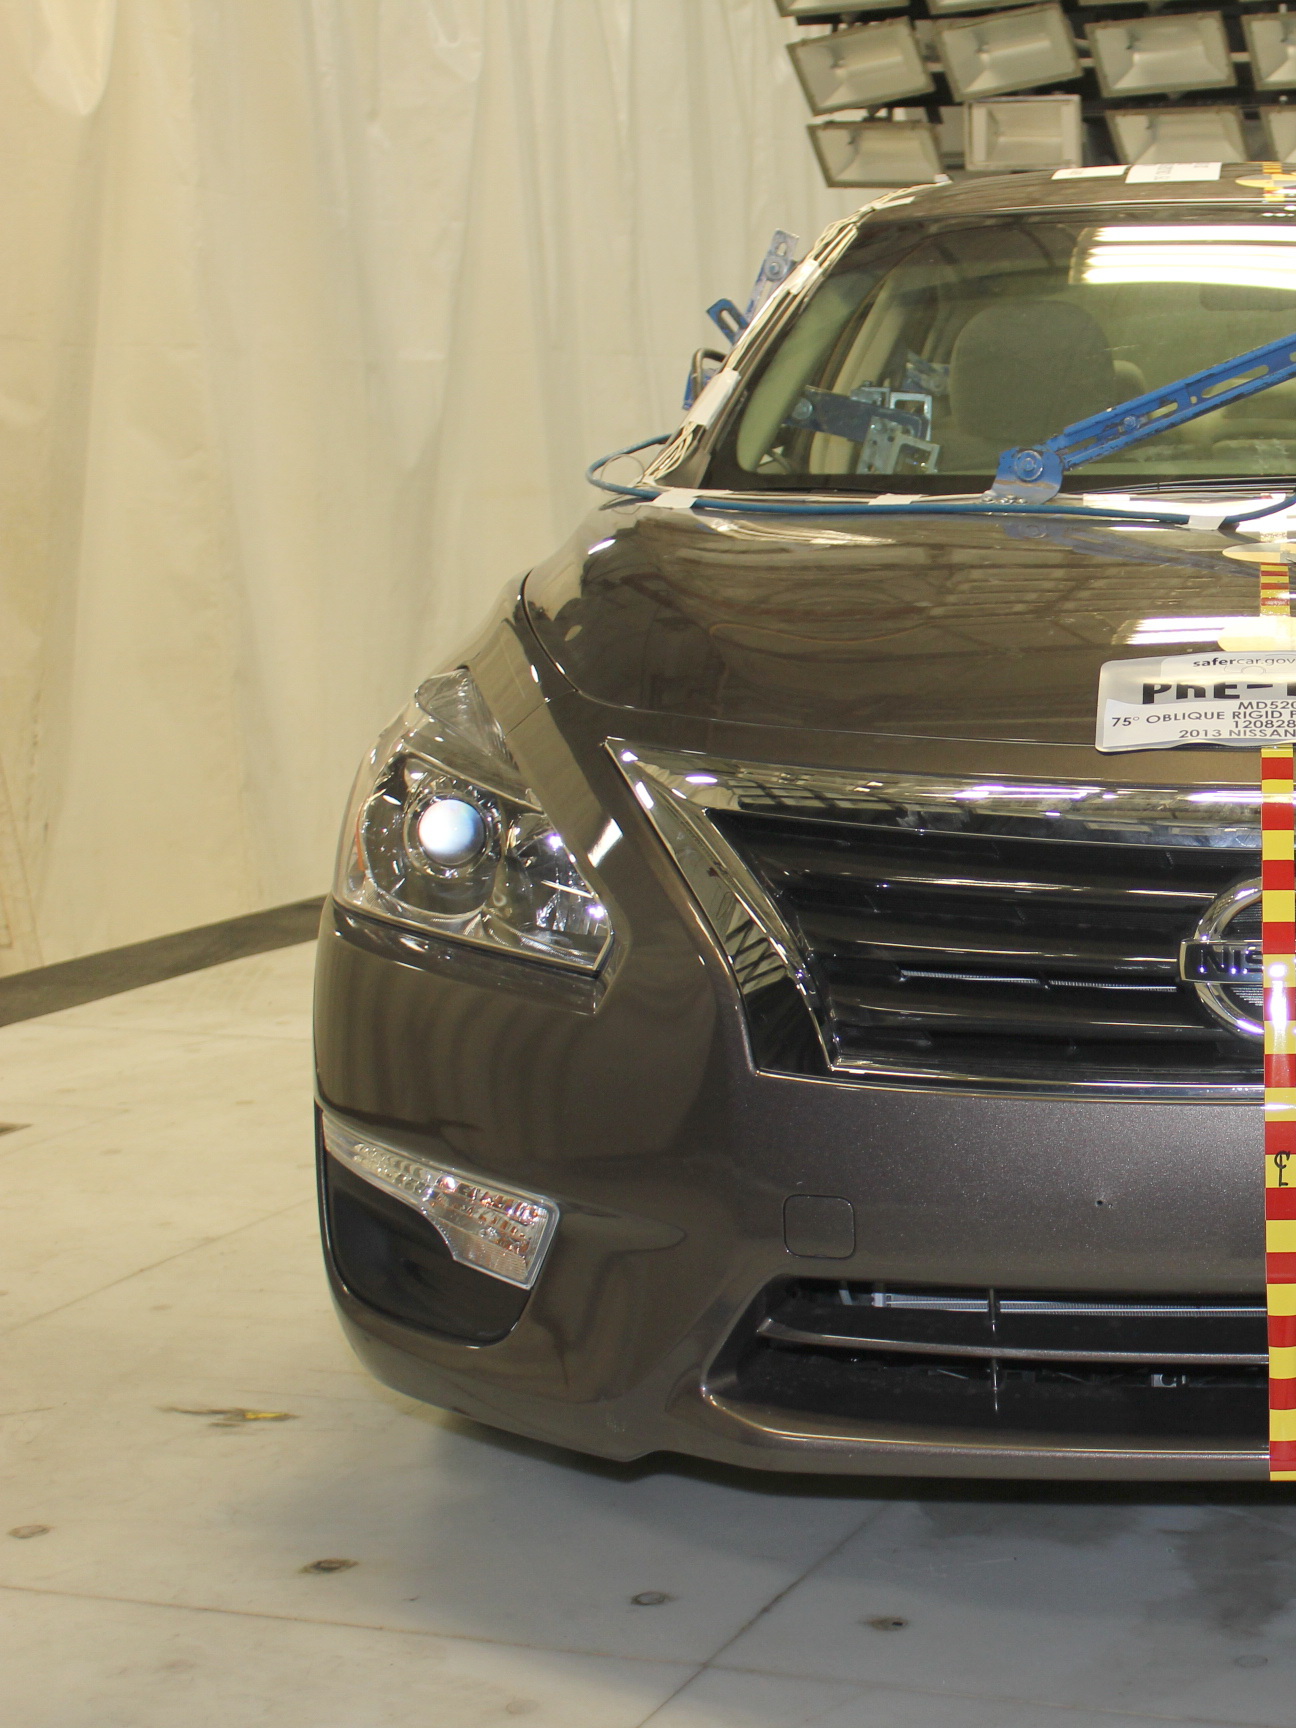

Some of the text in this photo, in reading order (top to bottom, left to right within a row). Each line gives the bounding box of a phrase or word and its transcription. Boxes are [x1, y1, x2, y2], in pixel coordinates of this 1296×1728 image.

[1193, 657, 1296, 667] safercar.gov
[1146, 711, 1225, 724] OBLIQUE
[1232, 709, 1283, 720] RIGID
[1178, 729, 1222, 739] 2013
[1229, 728, 1296, 738] NISSAN
